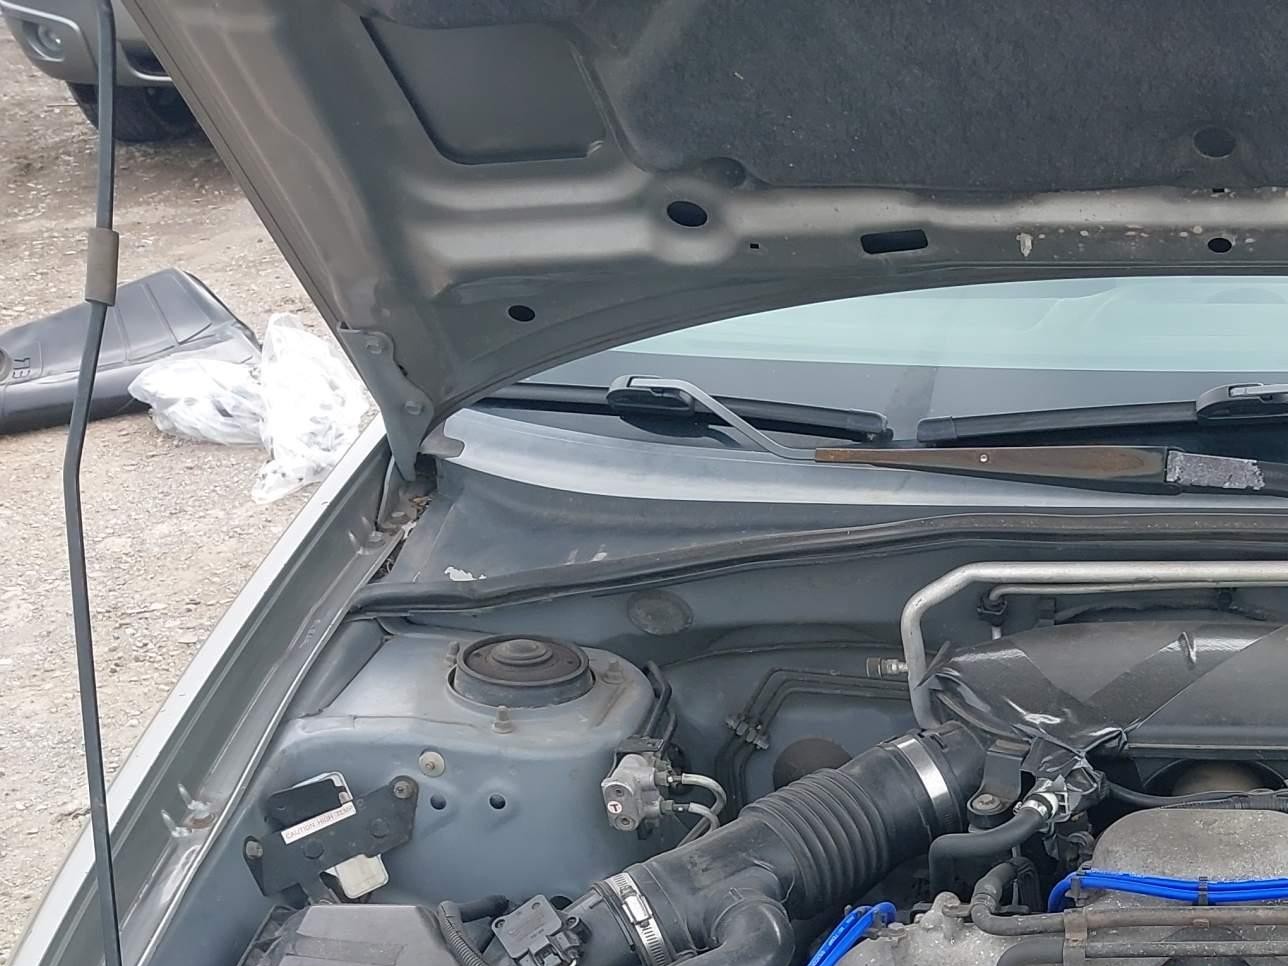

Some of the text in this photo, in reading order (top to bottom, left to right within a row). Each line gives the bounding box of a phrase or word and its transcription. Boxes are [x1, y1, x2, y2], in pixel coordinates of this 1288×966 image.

[610, 804, 619, 812] T
[286, 822, 316, 839] CAUTION
[318, 815, 335, 827] HIGH
